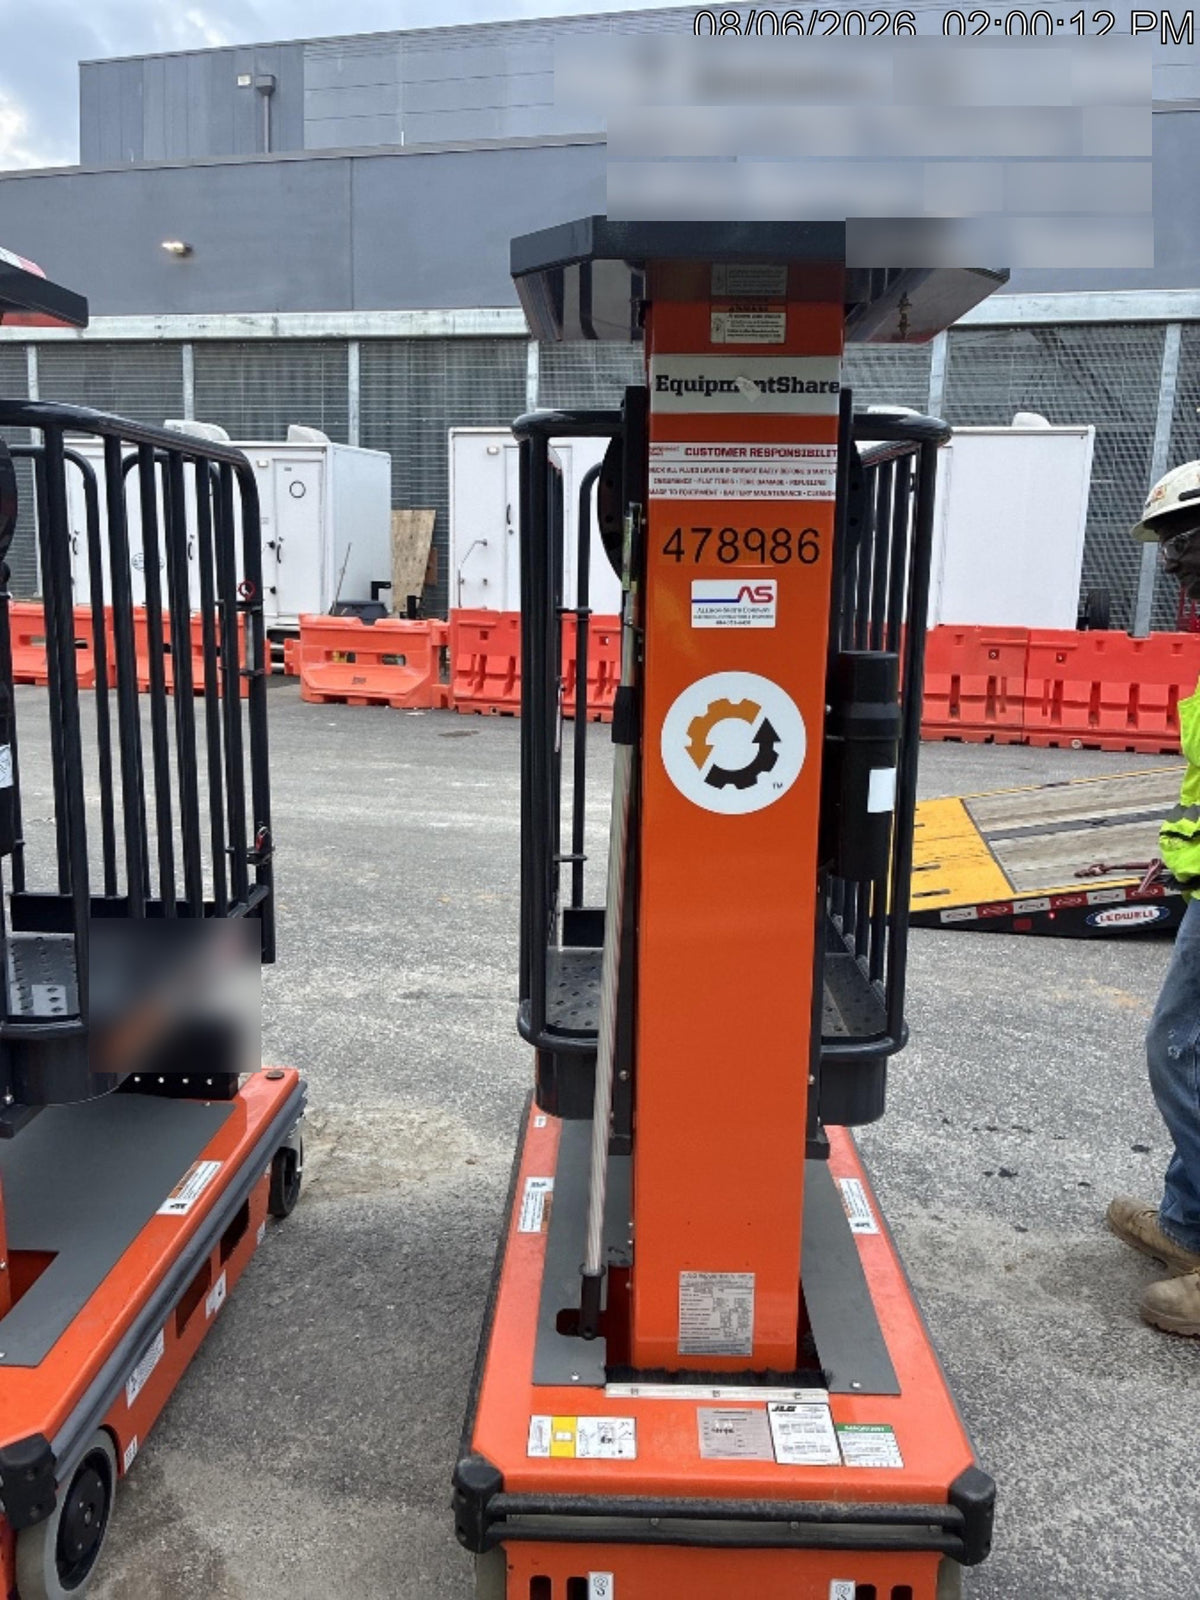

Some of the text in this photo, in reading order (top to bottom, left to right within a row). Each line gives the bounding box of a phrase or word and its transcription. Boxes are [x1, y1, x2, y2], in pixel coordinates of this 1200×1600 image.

[655, 374, 840, 397] EquipmntShare
[685, 447, 747, 458] CUSTOMER
[662, 527, 820, 564] 478986
[738, 585, 774, 603] AS
